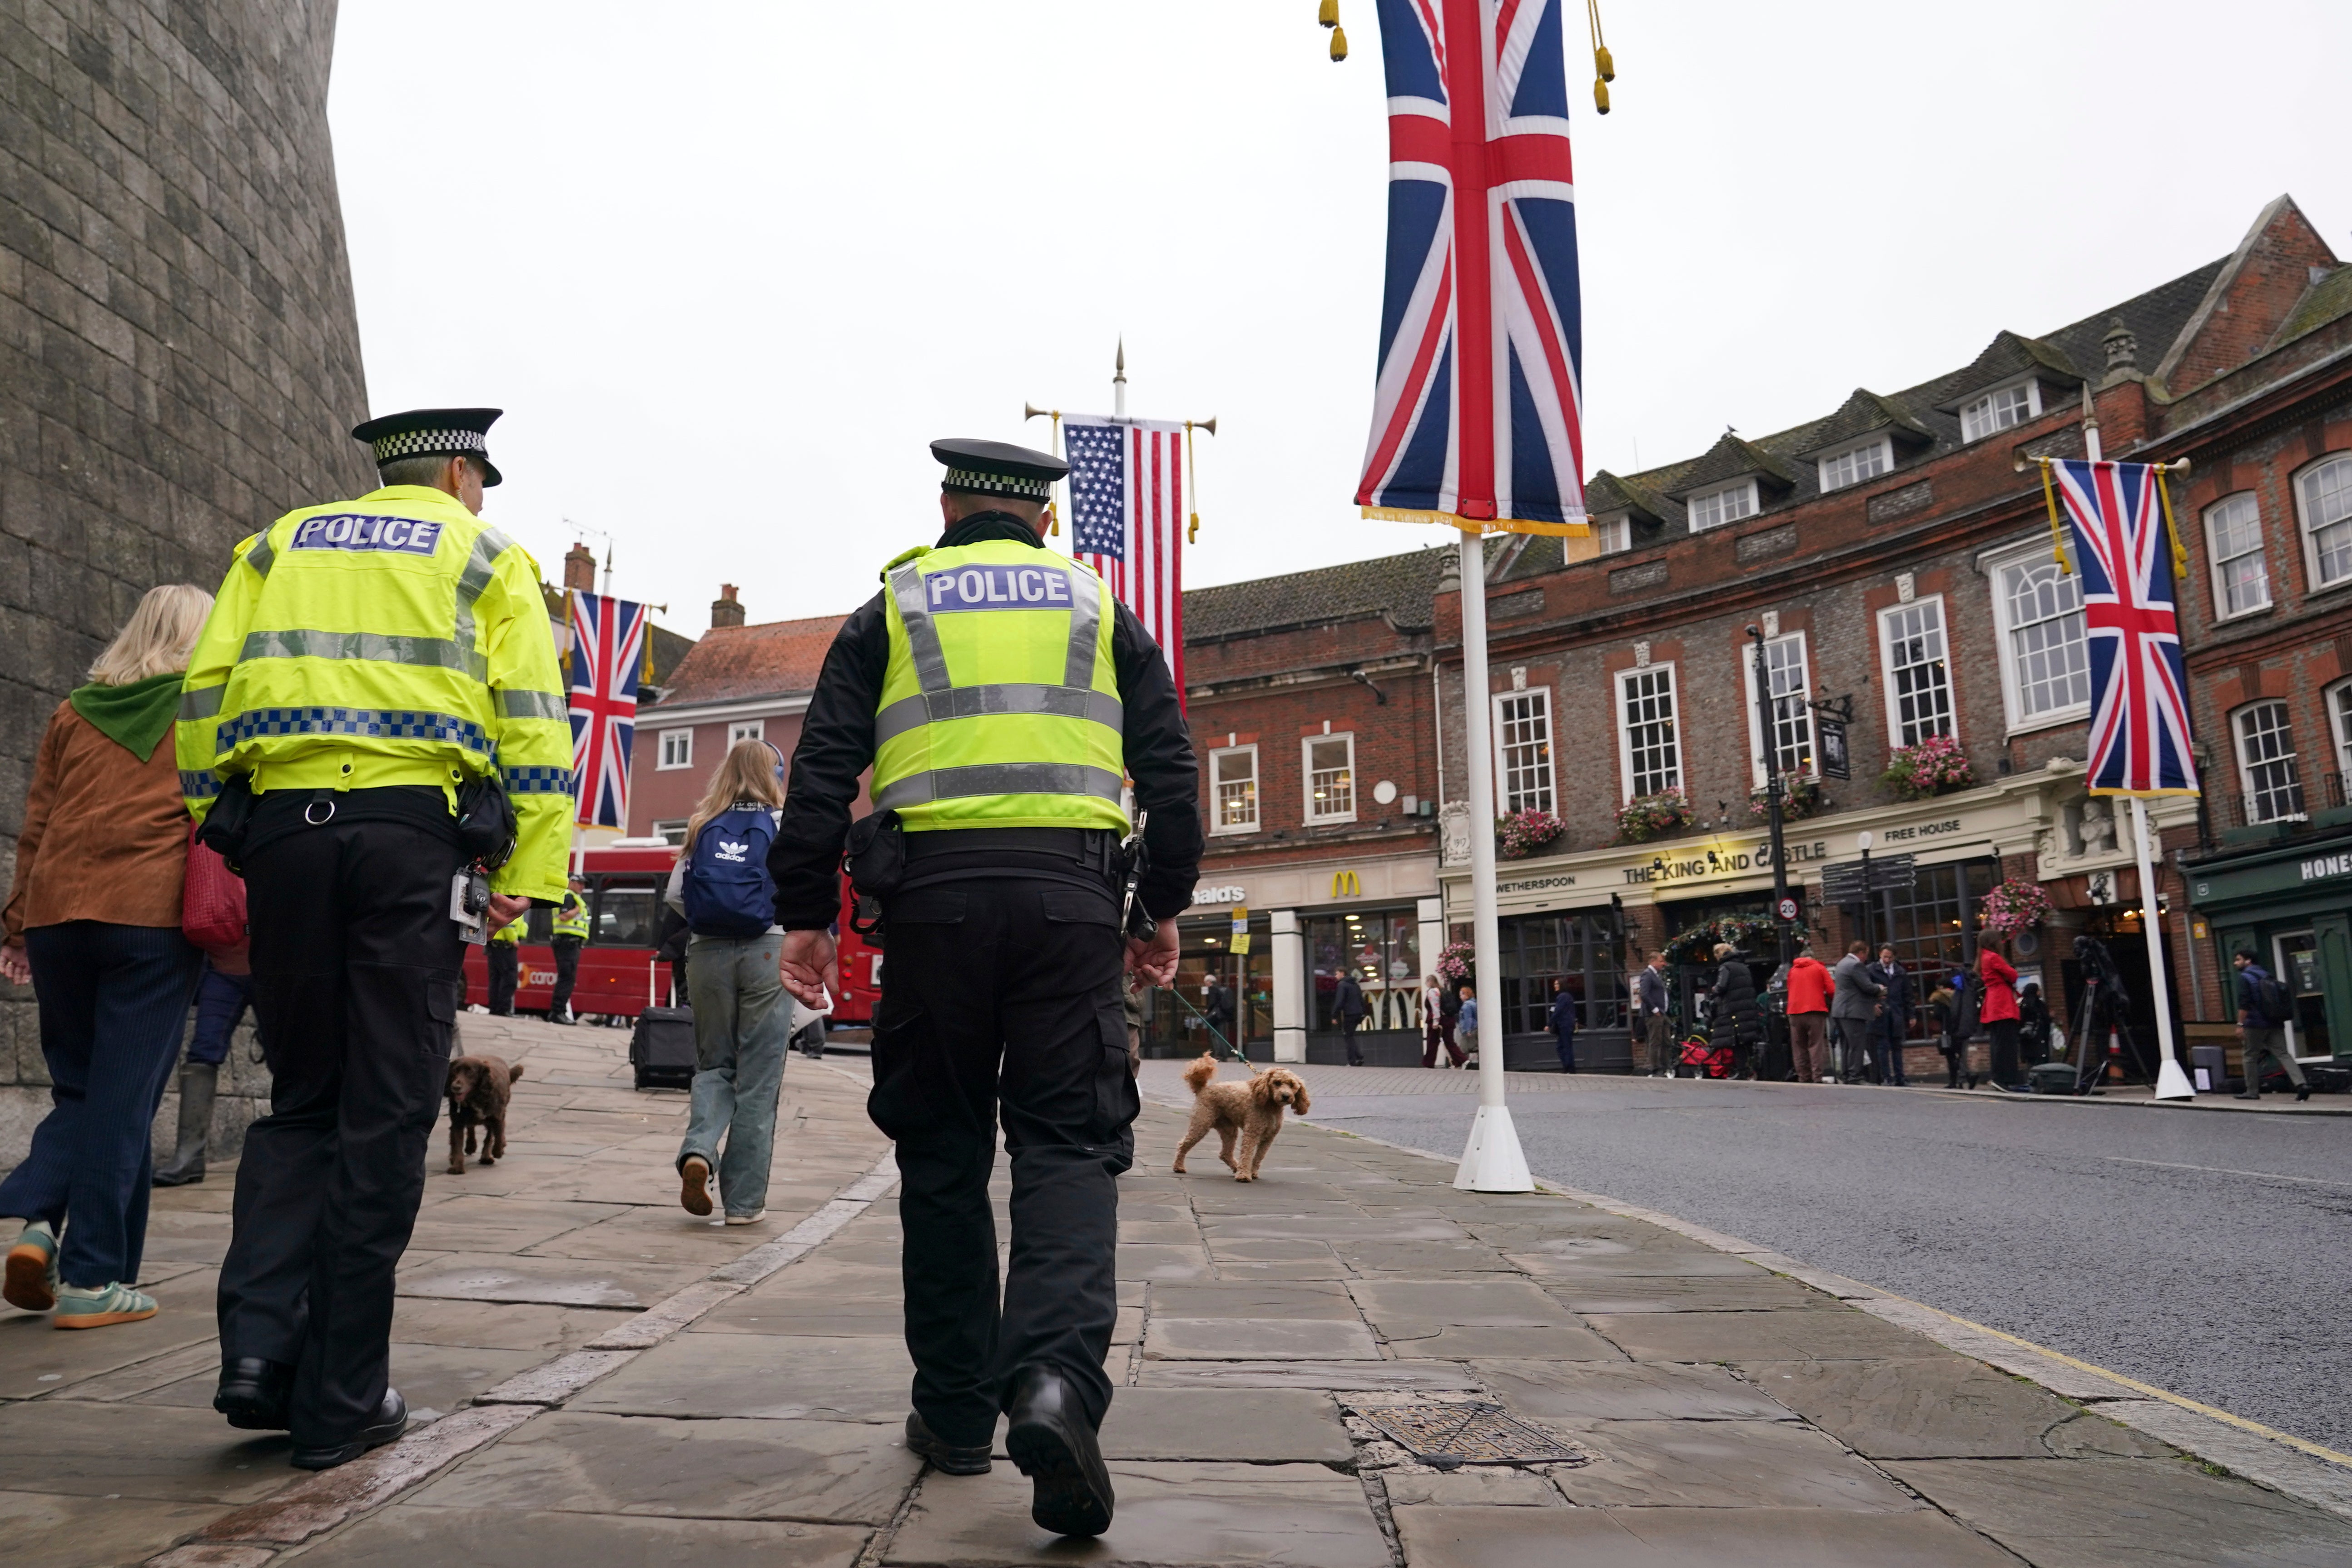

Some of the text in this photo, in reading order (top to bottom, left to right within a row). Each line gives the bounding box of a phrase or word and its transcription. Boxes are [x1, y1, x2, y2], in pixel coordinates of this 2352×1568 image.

[298, 516, 435, 549] POLICE
[931, 570, 1069, 605] POLICE
[1885, 819, 1960, 841] FREE HOUSE
[1454, 838, 1466, 848] 1917
[715, 852, 746, 862] adidas
[1623, 842, 1826, 883] THE KING AND CSTLE
[2301, 854, 2352, 880] HONE
[1496, 876, 1575, 893] WETHERSPOON
[1781, 904, 1794, 913] 20
